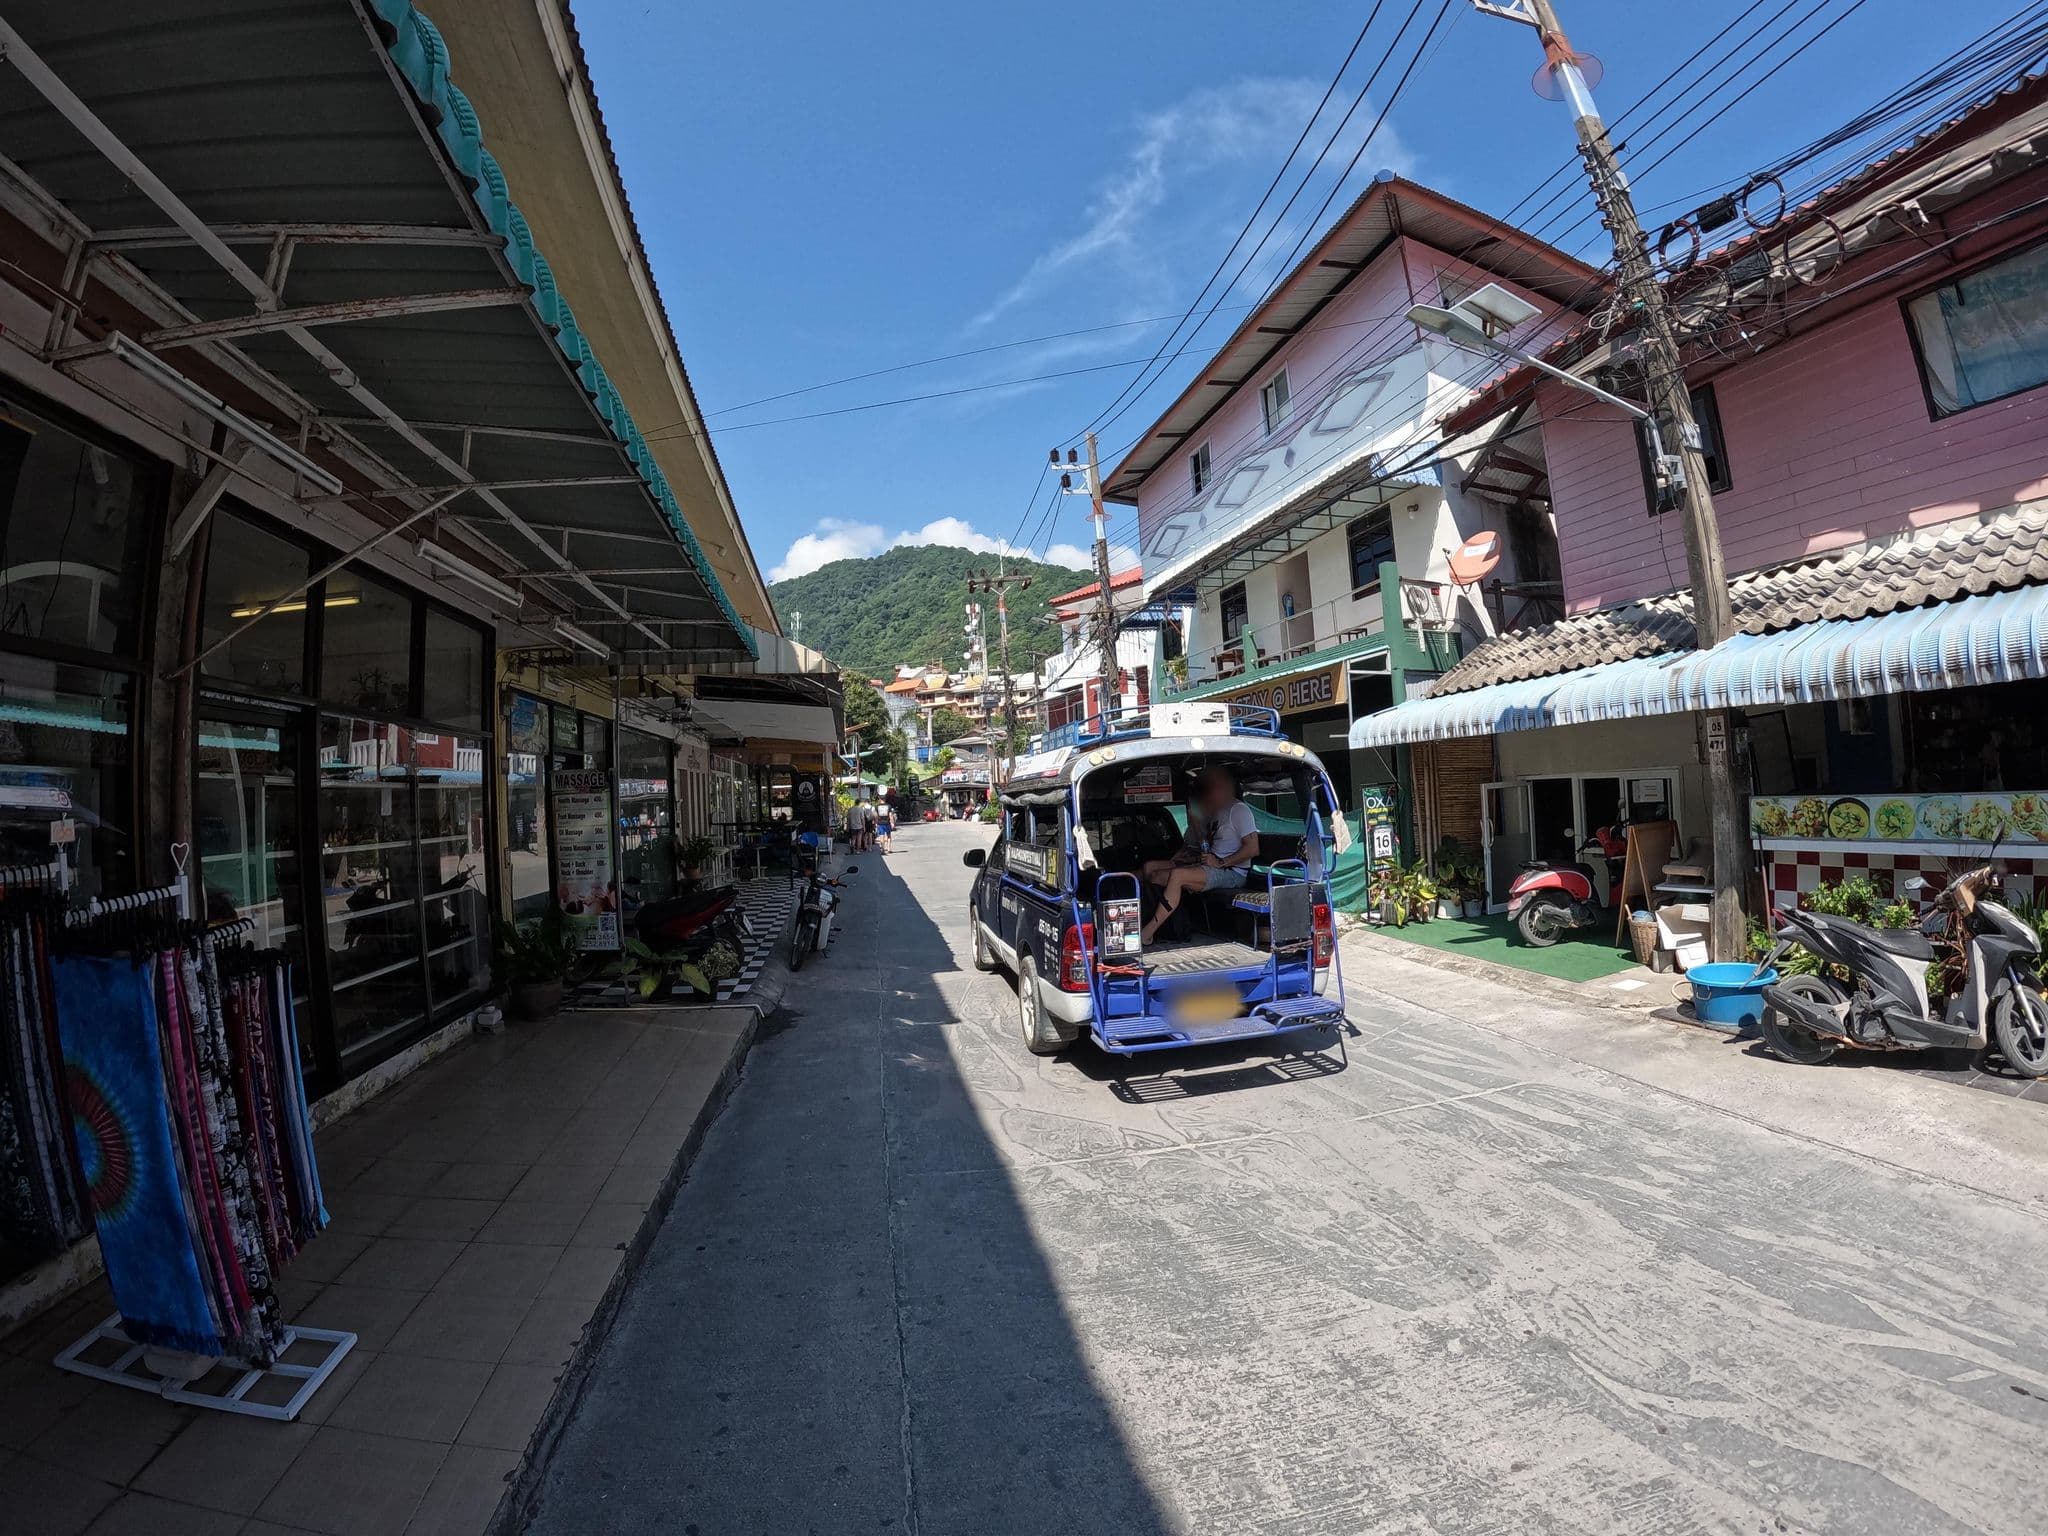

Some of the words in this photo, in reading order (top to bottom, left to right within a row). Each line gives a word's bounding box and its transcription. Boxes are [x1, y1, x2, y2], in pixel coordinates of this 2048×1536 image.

[1272, 686, 1285, 709] @
[1288, 672, 1332, 708] HERE
[1711, 722, 1721, 731] 05
[1709, 740, 1725, 750] 471
[555, 773, 605, 787] MASSAGE
[1376, 834, 1390, 848] 16
